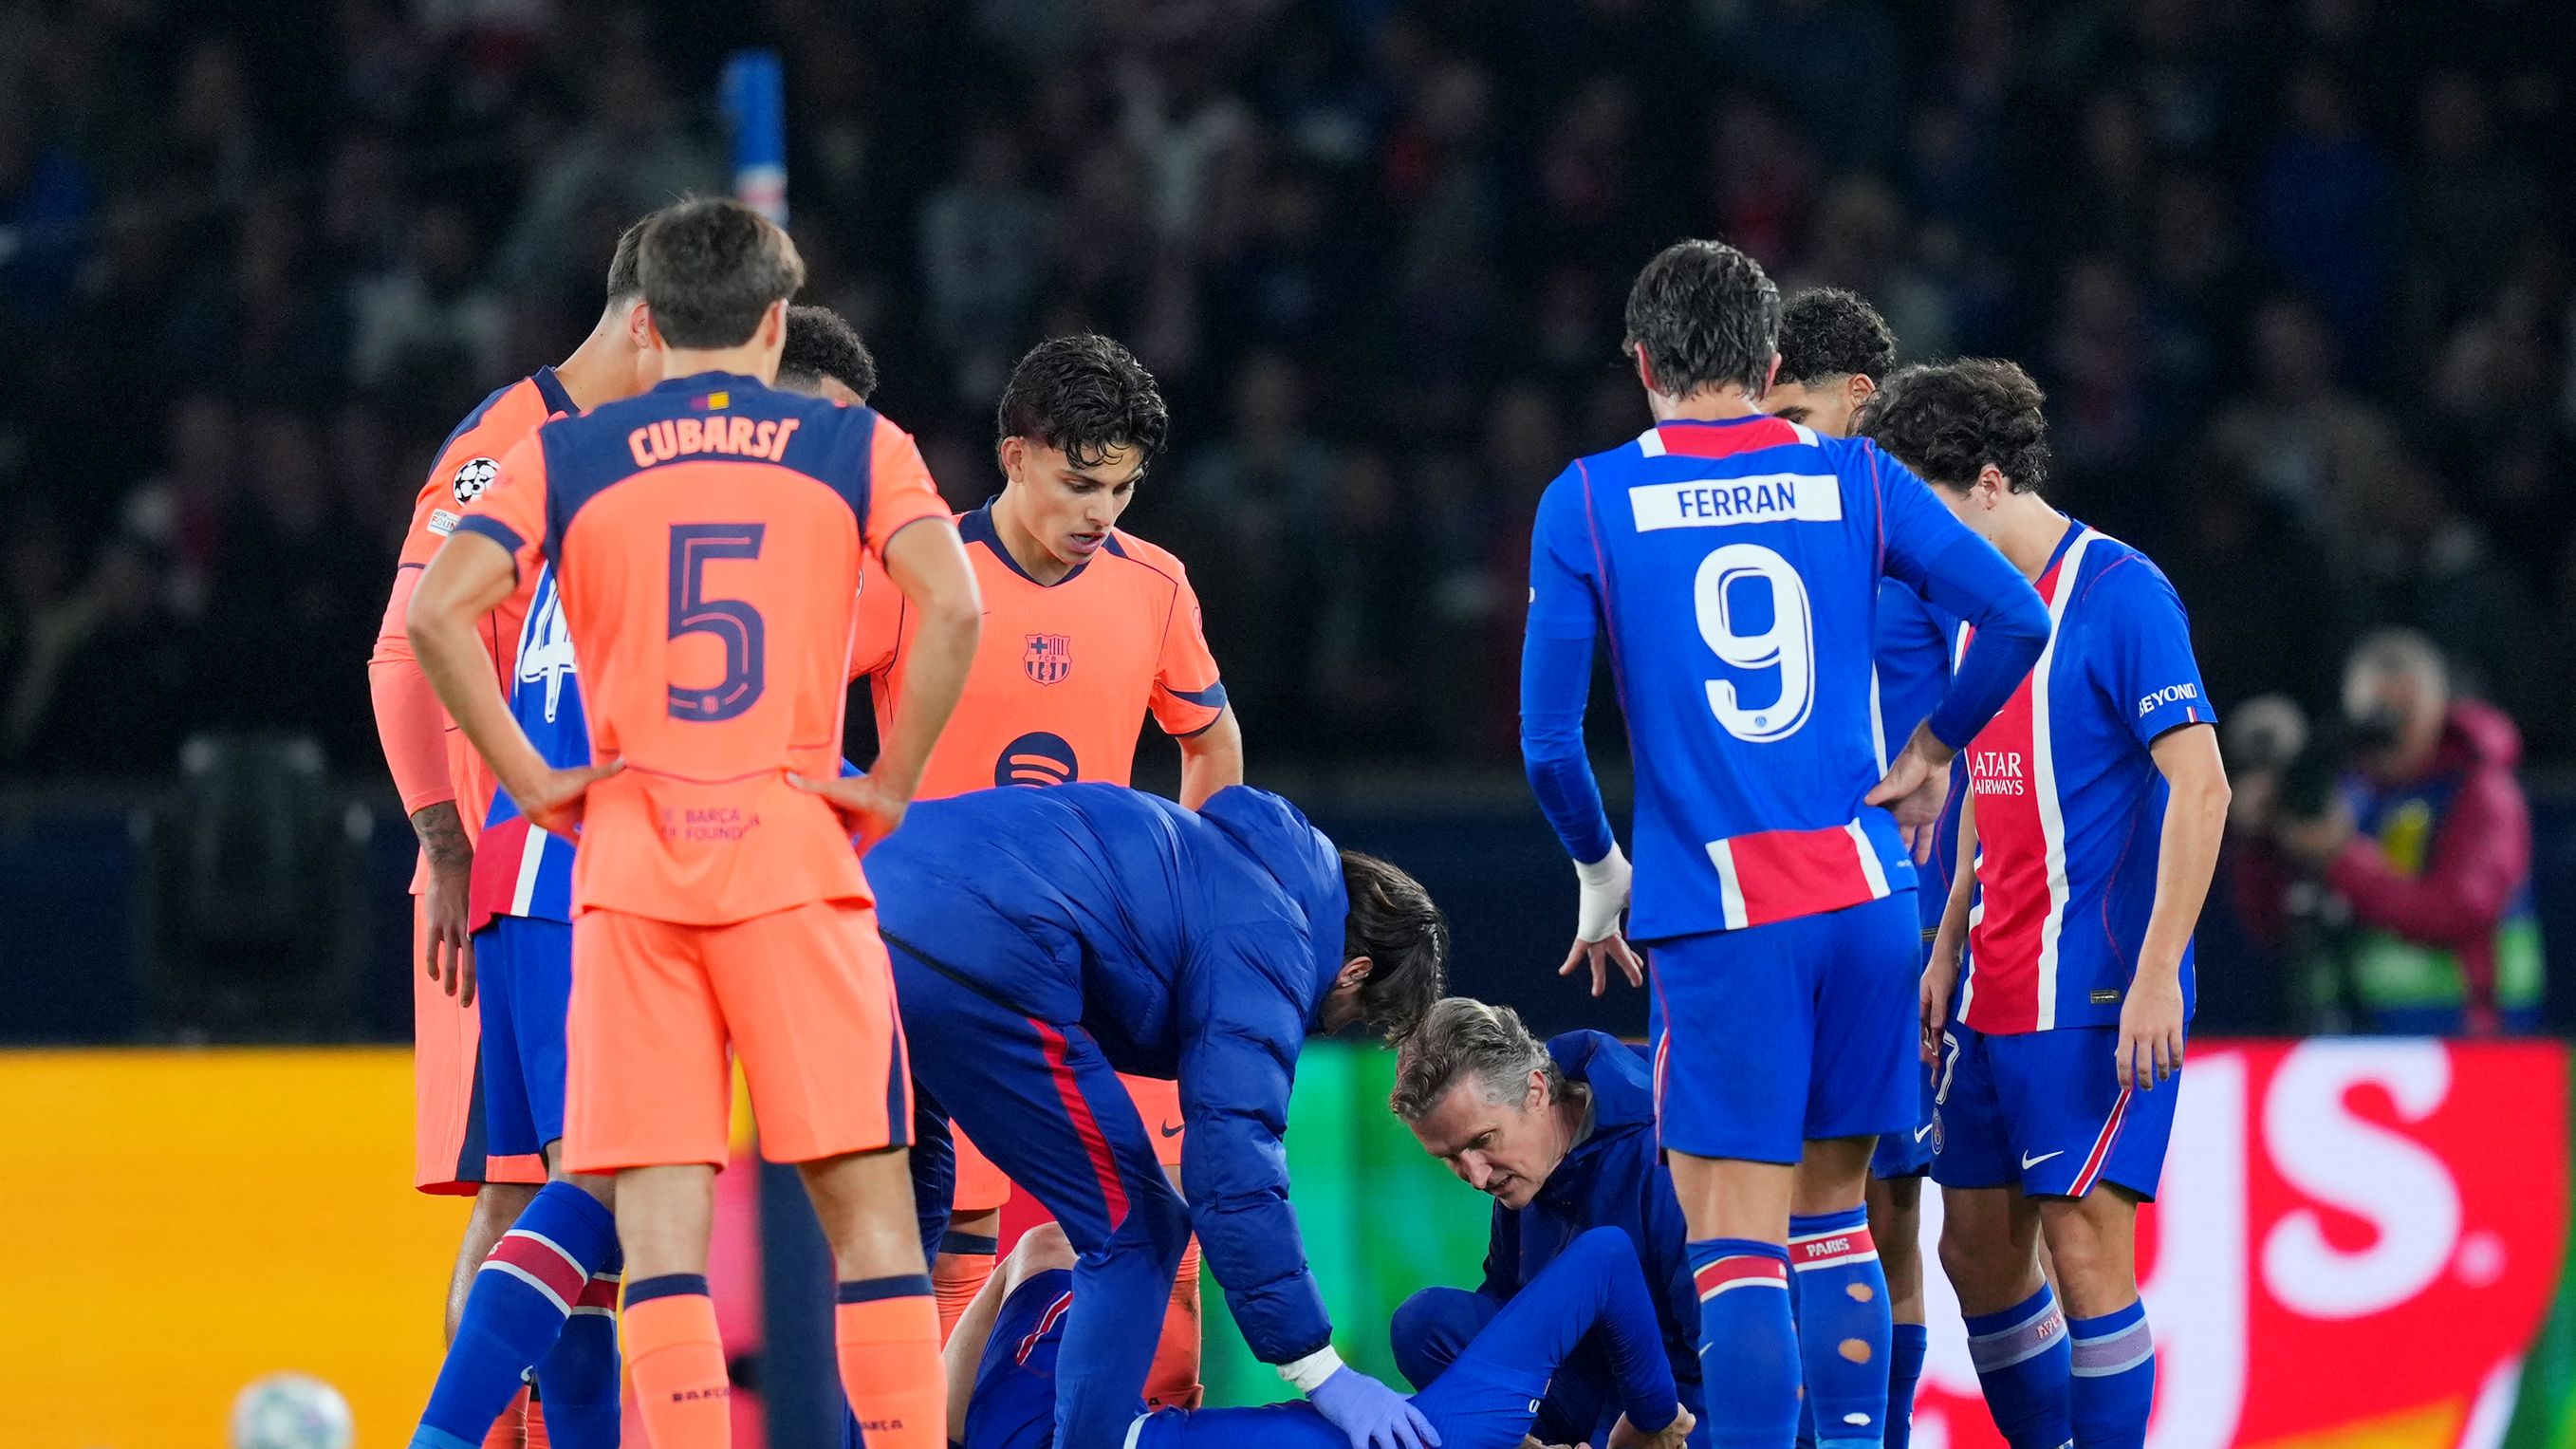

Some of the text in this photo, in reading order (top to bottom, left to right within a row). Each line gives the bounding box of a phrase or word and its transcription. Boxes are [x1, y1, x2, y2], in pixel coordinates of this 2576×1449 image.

[1677, 481, 1796, 518] FERRAN
[668, 523, 766, 721] 5
[515, 560, 578, 724] 4
[1694, 543, 1815, 743] 9
[1973, 751, 2023, 777] ATAR
[1974, 779, 2024, 795] AIRWAYS
[1806, 1237, 1850, 1257] PARIS
